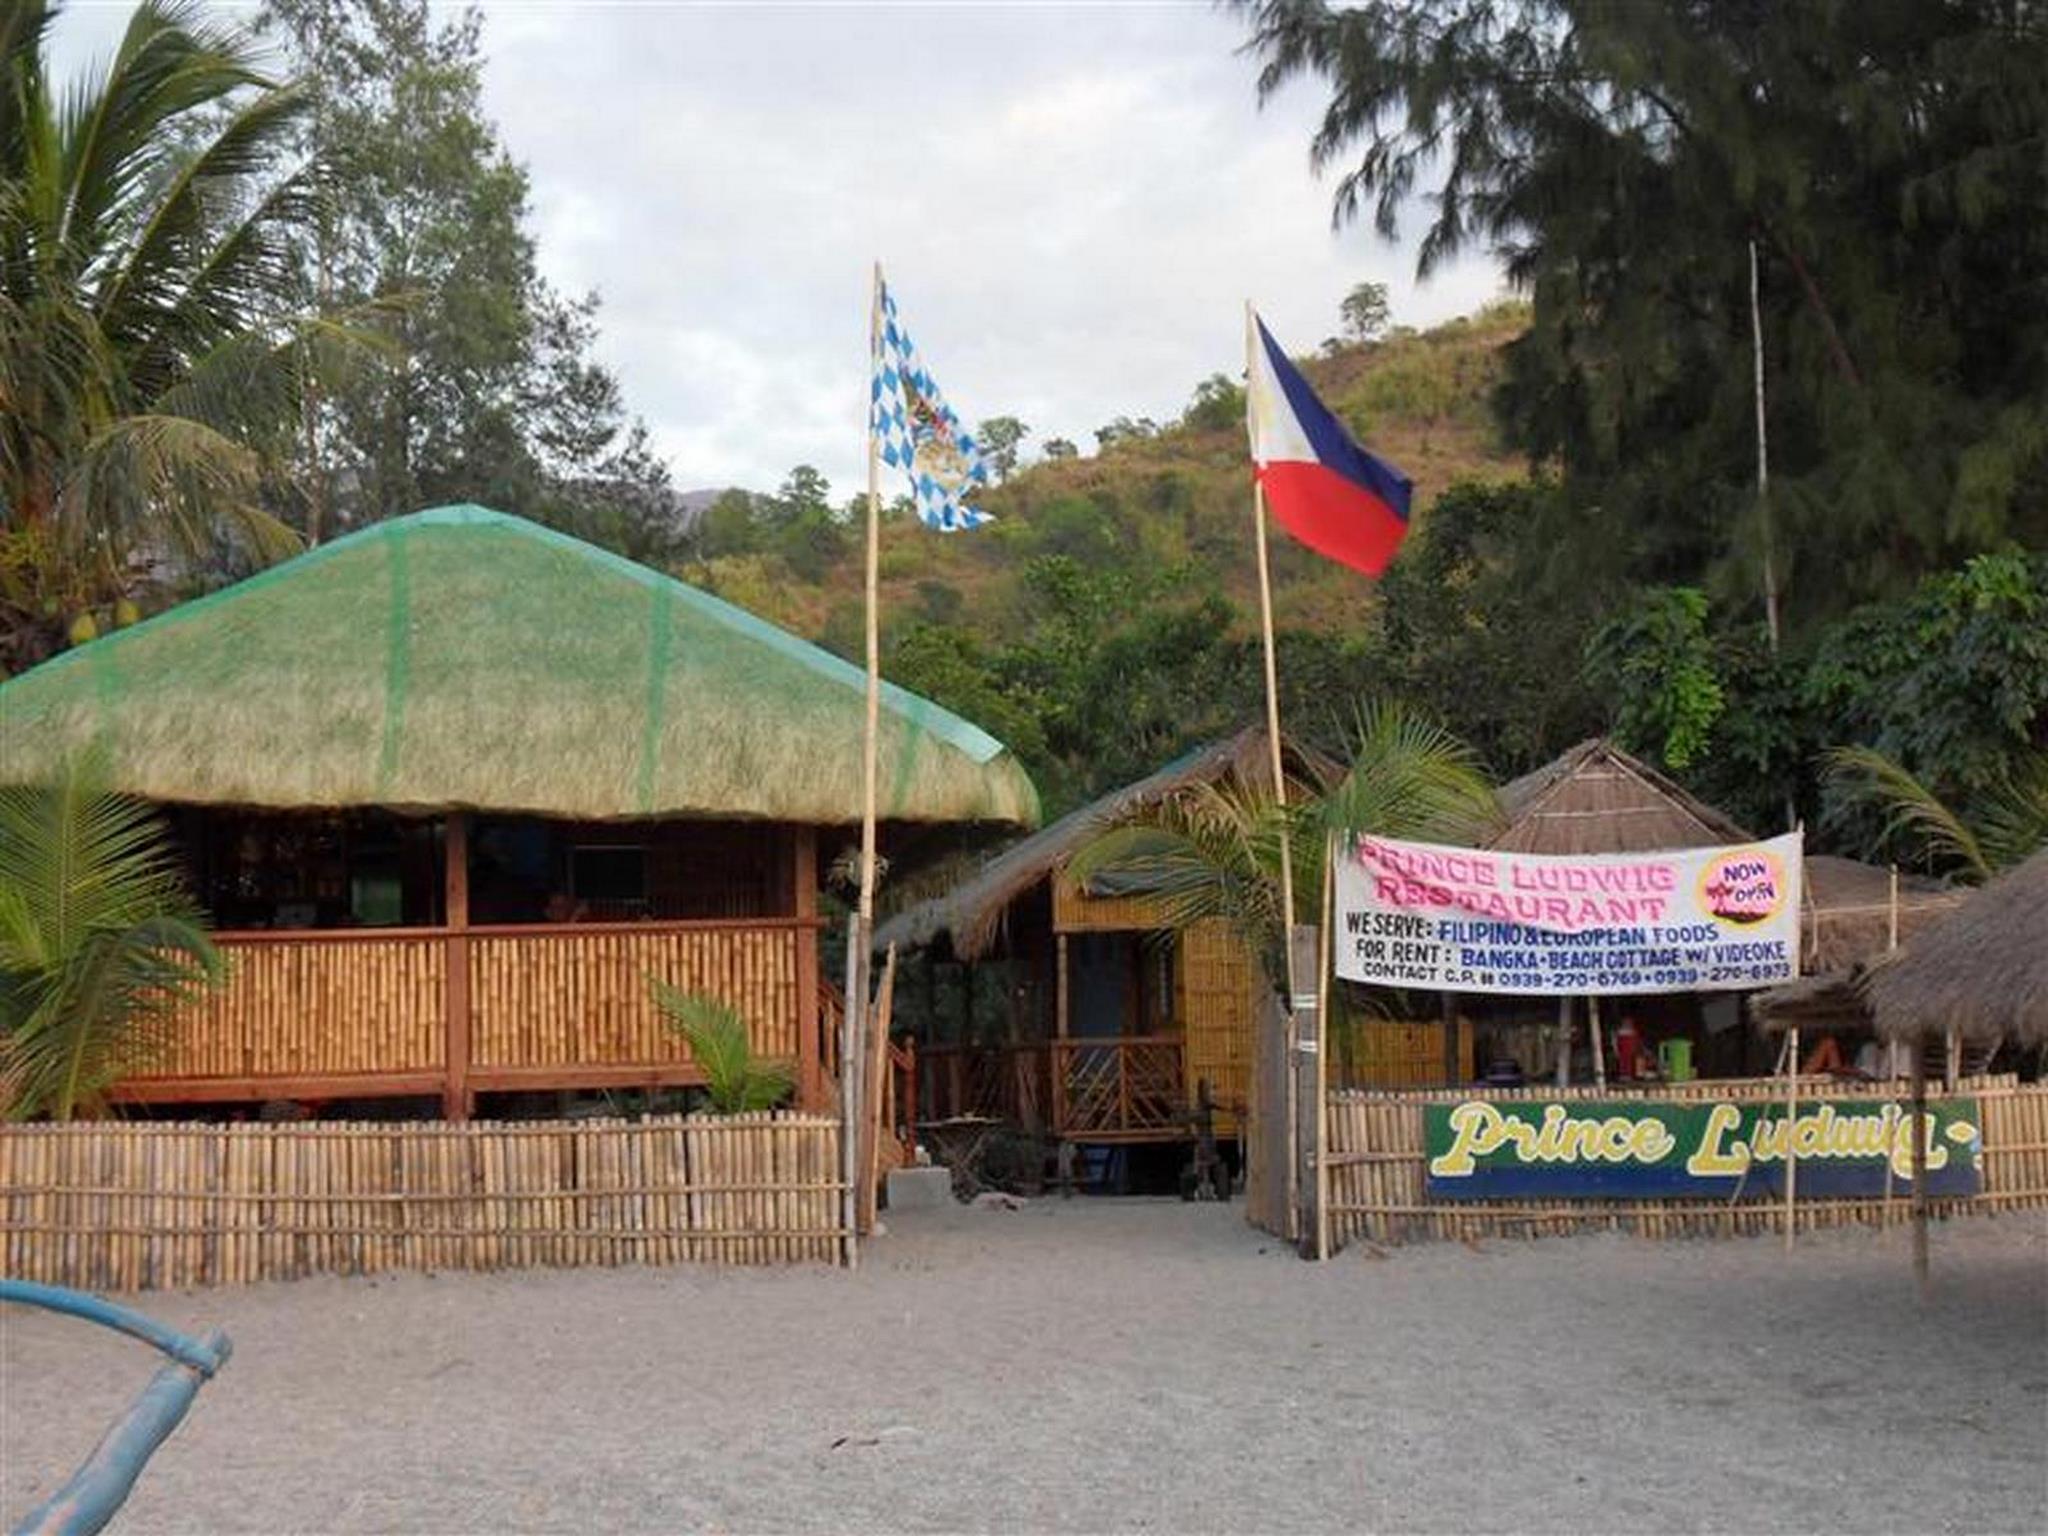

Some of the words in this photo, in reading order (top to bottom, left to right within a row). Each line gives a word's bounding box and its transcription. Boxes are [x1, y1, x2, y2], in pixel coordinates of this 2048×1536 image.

[1359, 842, 1497, 887] PRINCE
[1511, 862, 1677, 893] LUDWIG
[1724, 862, 1766, 882] NOW
[1373, 875, 1666, 929] RESTAURANT
[1346, 911, 1370, 935] WE
[1373, 914, 1433, 940] SERVE:
[1653, 923, 1719, 943] FOODS
[1356, 938, 1385, 961] FOR
[1605, 947, 1682, 970] COTTAGE
[1713, 940, 1785, 963] VIDEOKE
[1363, 962, 1438, 981] CONTACT
[1430, 1101, 1676, 1177] Prince
[1687, 1104, 1948, 1179] Ludwig
